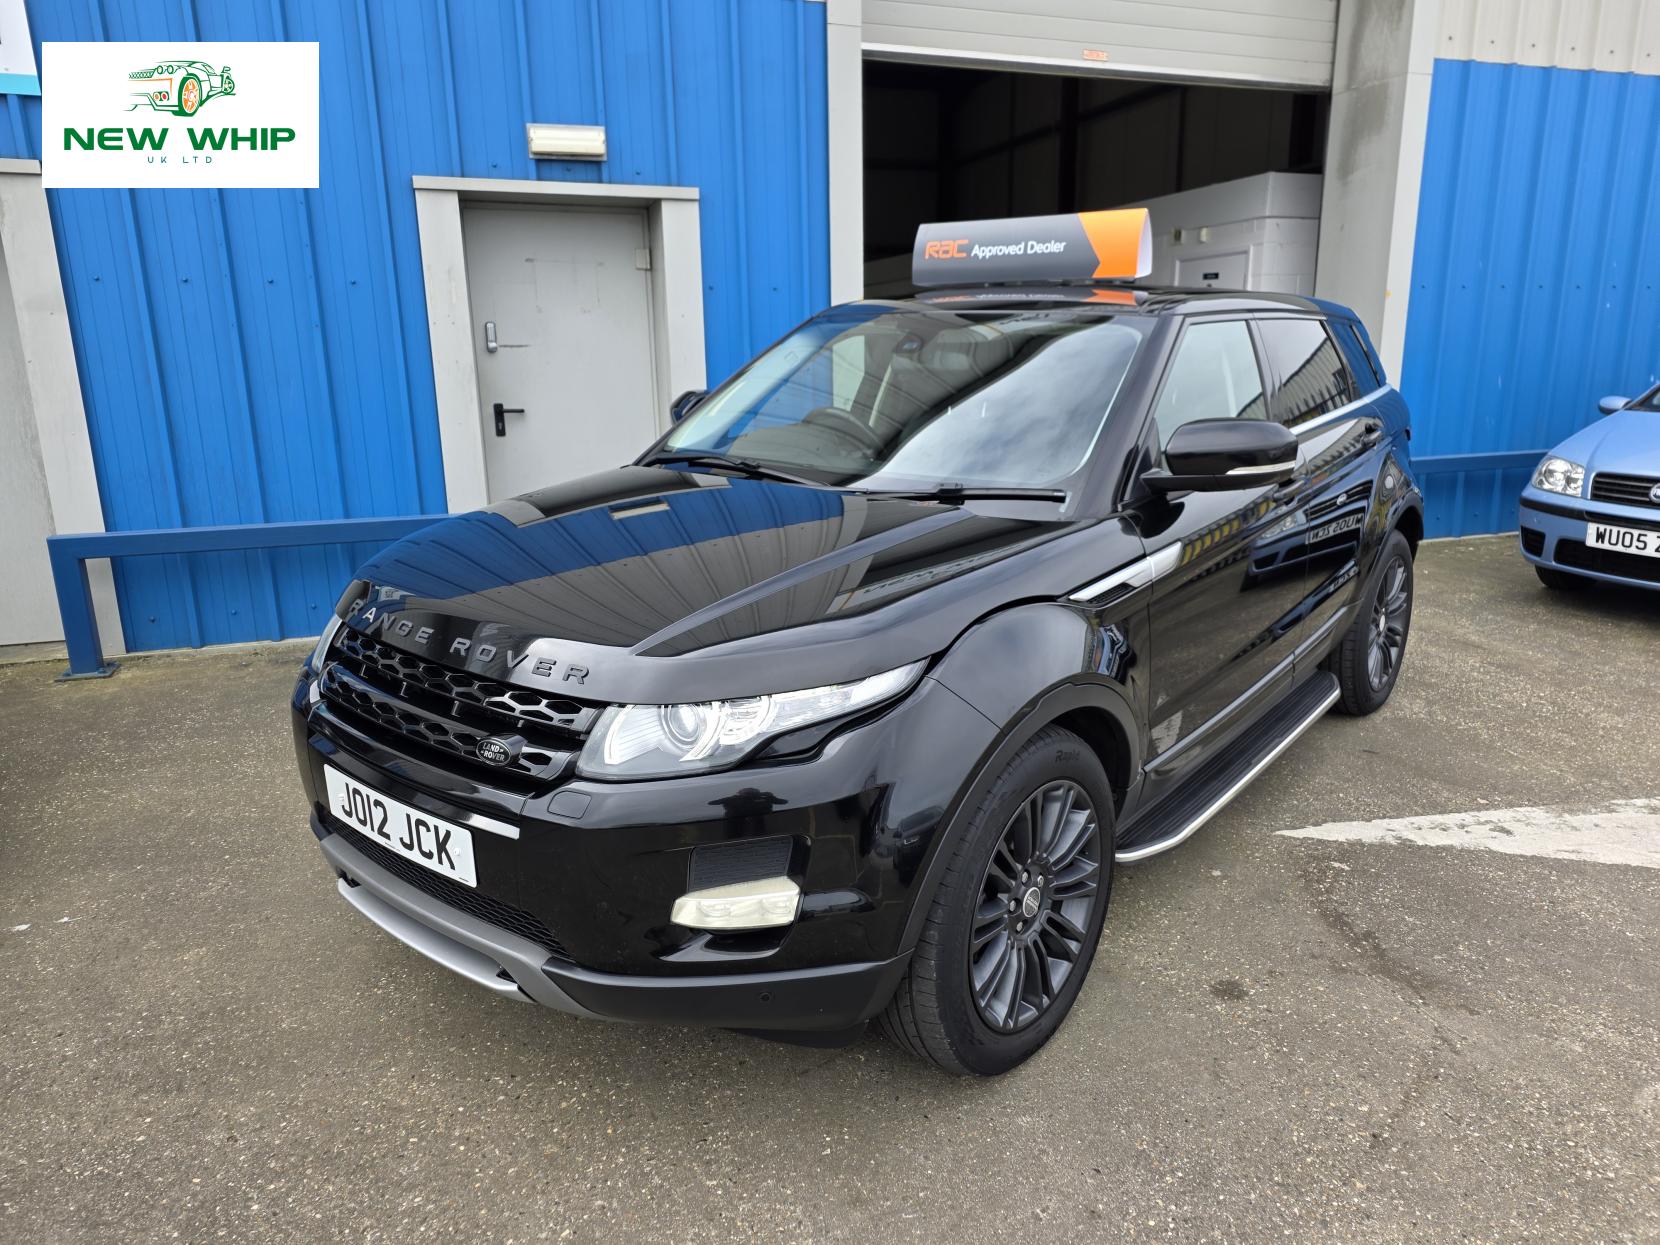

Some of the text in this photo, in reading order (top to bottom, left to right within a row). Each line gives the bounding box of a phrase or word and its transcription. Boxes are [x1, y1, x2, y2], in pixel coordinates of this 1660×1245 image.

[924, 239, 1067, 260] RAC Approved Dealer
[1595, 526, 1648, 551] WU05
[348, 598, 590, 685] RANGE ROVER
[482, 742, 500, 752] LAND
[483, 750, 505, 761] ROVER
[341, 782, 456, 871] JO12 JCK
